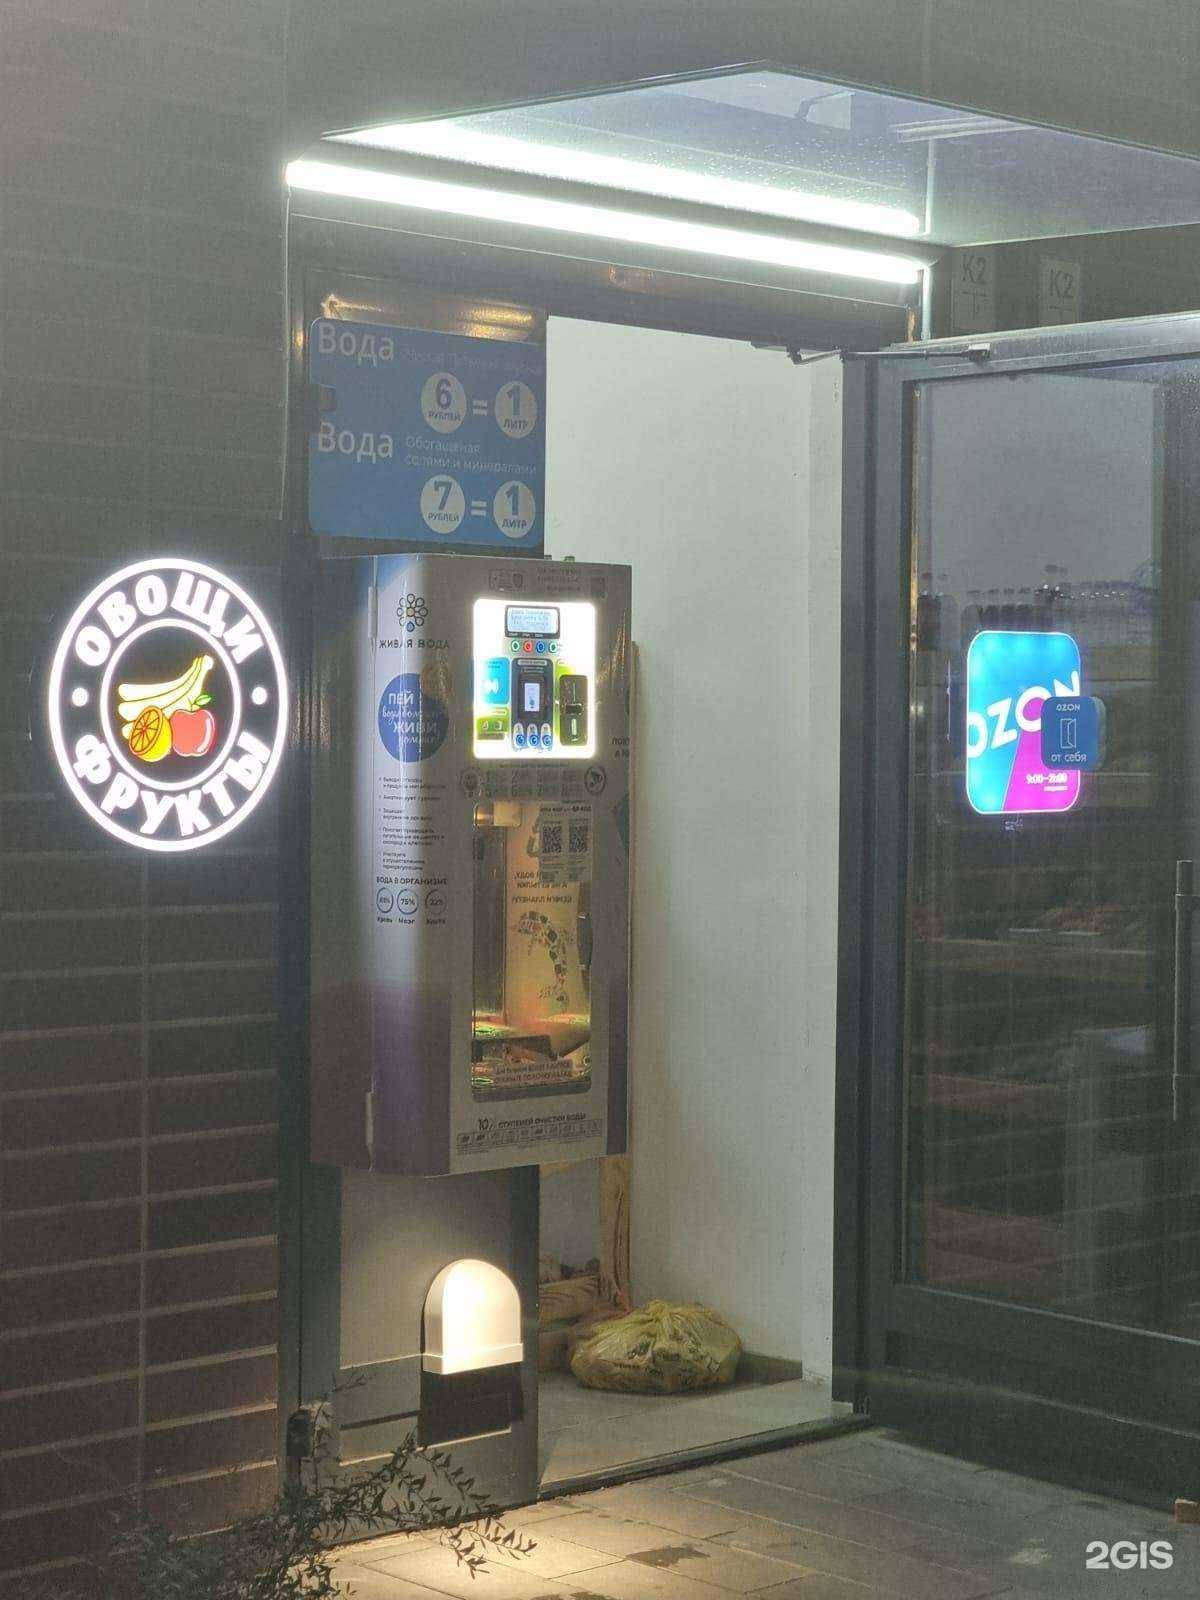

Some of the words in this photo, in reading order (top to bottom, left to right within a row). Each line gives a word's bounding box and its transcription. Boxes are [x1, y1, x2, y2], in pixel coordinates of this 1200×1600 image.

[318, 322, 394, 366] Вода
[435, 378, 453, 409] 6
[506, 385, 520, 416] 1
[428, 408, 461, 422] РУБЛЕЙ
[503, 418, 529, 431] ЛИТР
[318, 421, 394, 464] Вода
[433, 481, 452, 511] 7
[505, 485, 519, 515] 1
[428, 511, 460, 523] РУБЛЕЙ
[502, 517, 527, 529] ЛИТР
[75, 571, 264, 667] ОВОЩИ
[417, 639, 450, 650] ВОДА
[388, 690, 414, 705] ПЕЙ
[1056, 703, 1081, 712] OZON
[1051, 754, 1060, 762] от
[1064, 751, 1088, 762] себя
[73, 731, 271, 837] ФРУКТЫ
